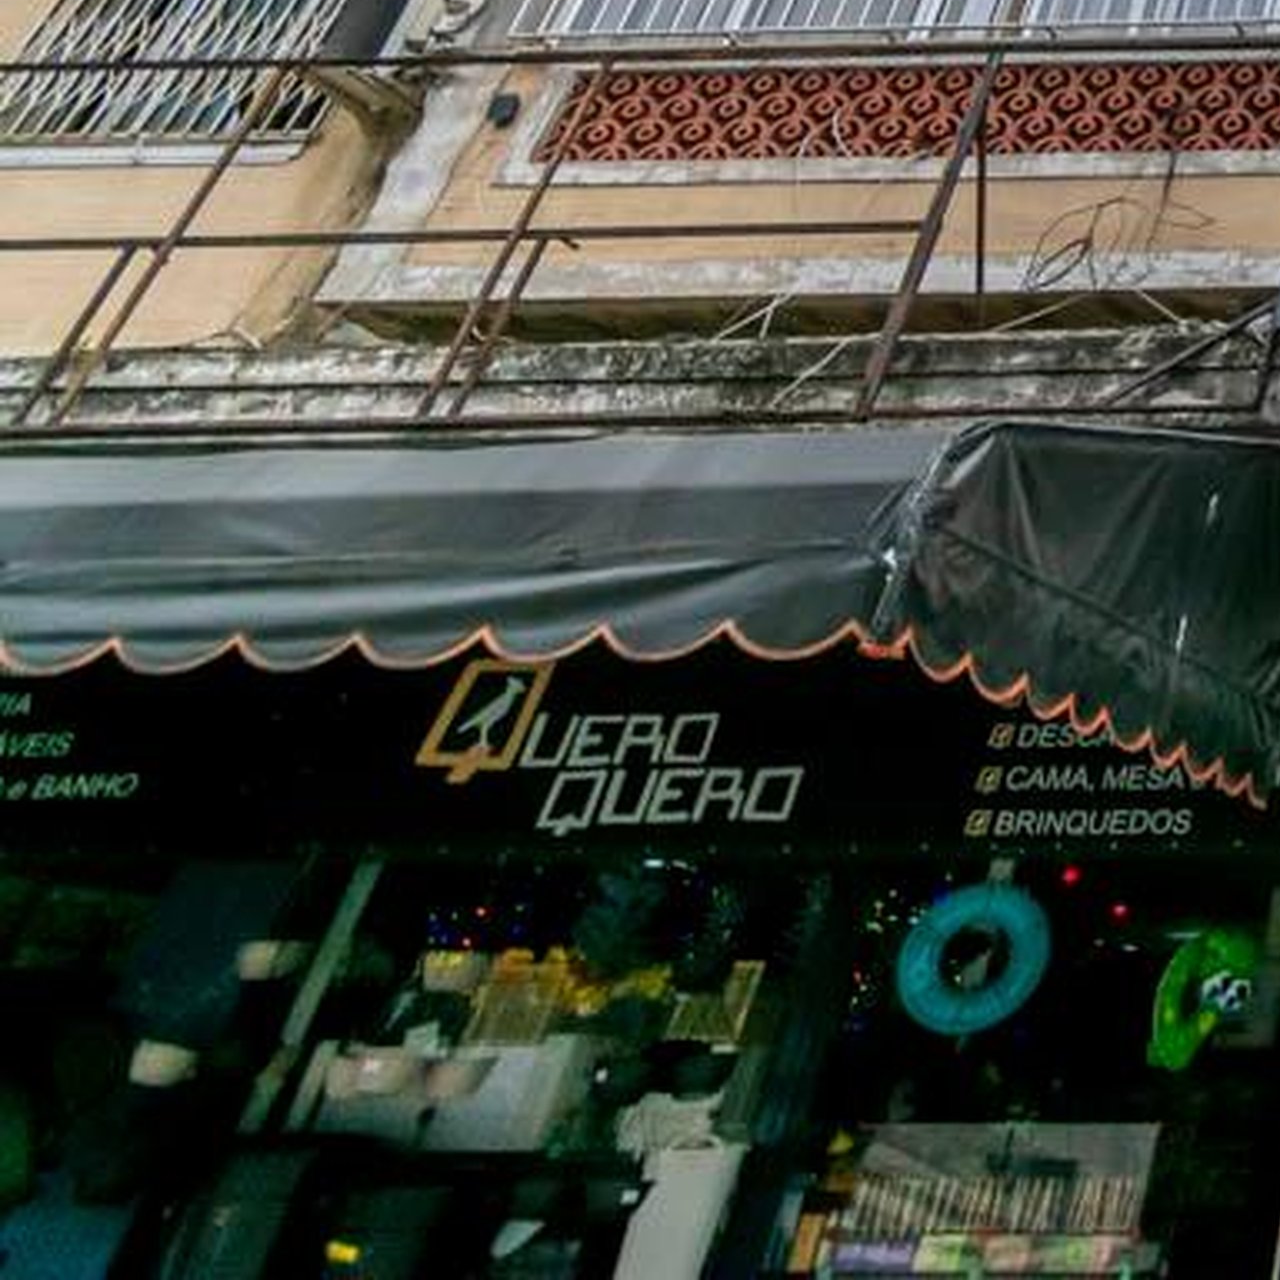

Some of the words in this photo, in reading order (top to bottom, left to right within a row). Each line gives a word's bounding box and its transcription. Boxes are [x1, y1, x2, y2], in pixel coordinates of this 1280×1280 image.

[414, 659, 720, 785] QUERO
[31, 773, 140, 801] BANHO
[1101, 766, 1185, 792] MESA
[535, 766, 804, 838] QUERO
[993, 808, 1194, 836] BRINQUEDOS
